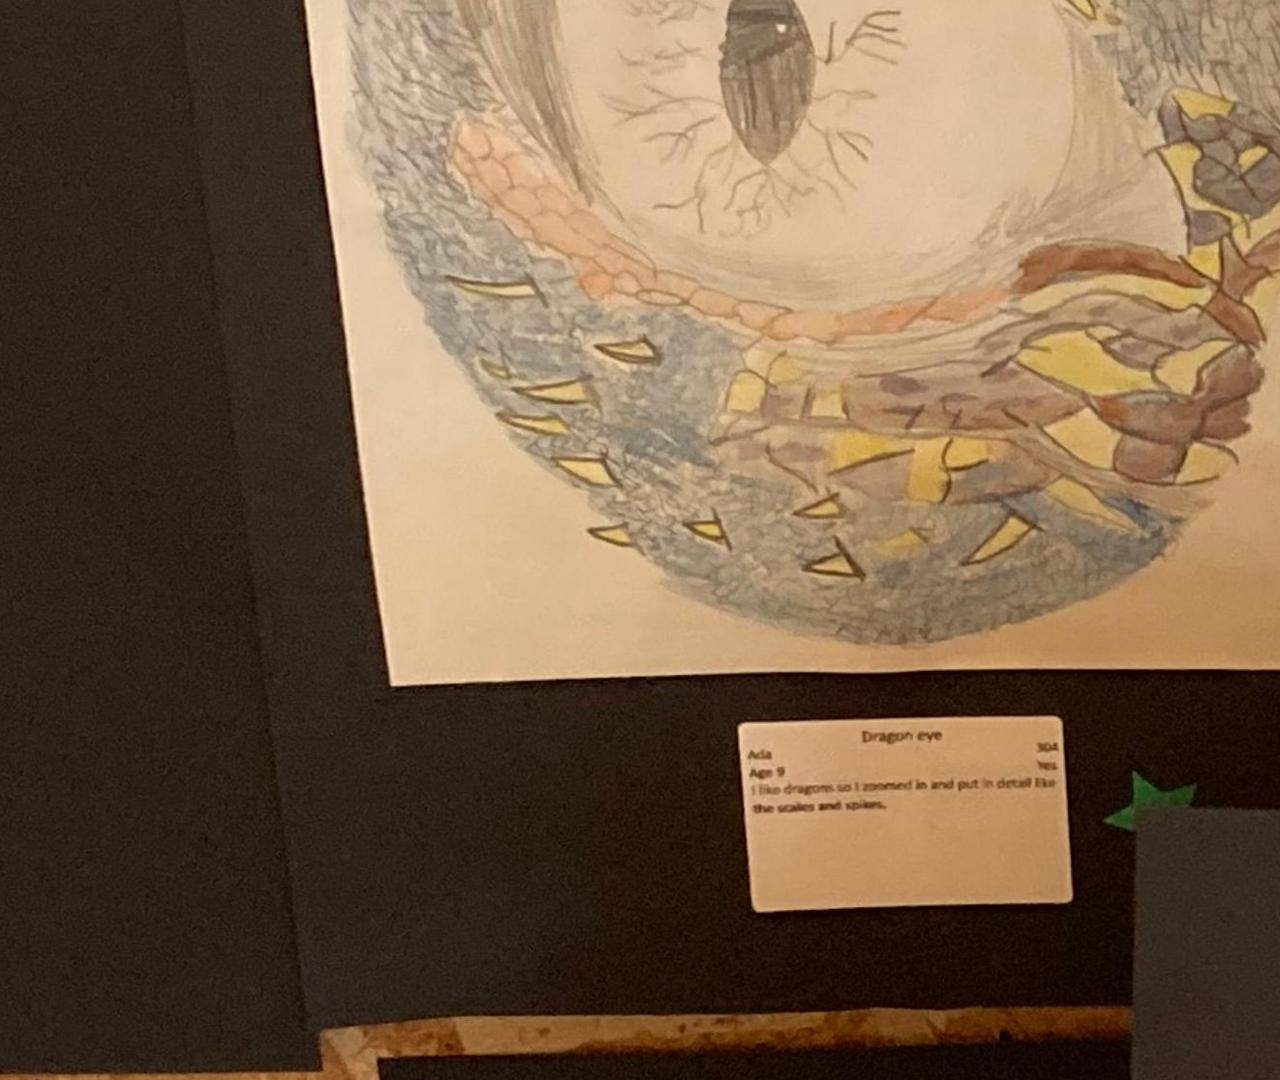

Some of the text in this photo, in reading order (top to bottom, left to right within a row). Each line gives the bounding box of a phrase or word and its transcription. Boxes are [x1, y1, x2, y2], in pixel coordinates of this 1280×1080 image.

[861, 730, 943, 744] Dragon eye
[1036, 760, 1058, 771] Yes
[749, 768, 773, 779] Age
[759, 783, 781, 795] like
[837, 783, 852, 793] so
[862, 779, 913, 792] zoomed
[916, 778, 928, 790] in
[931, 778, 954, 790] and
[957, 777, 979, 792] put
[982, 777, 993, 789] in
[996, 777, 1032, 789] detail
[1034, 776, 1056, 788] like
[753, 803, 775, 814] the
[777, 801, 815, 813] scales
[818, 800, 842, 812] and
